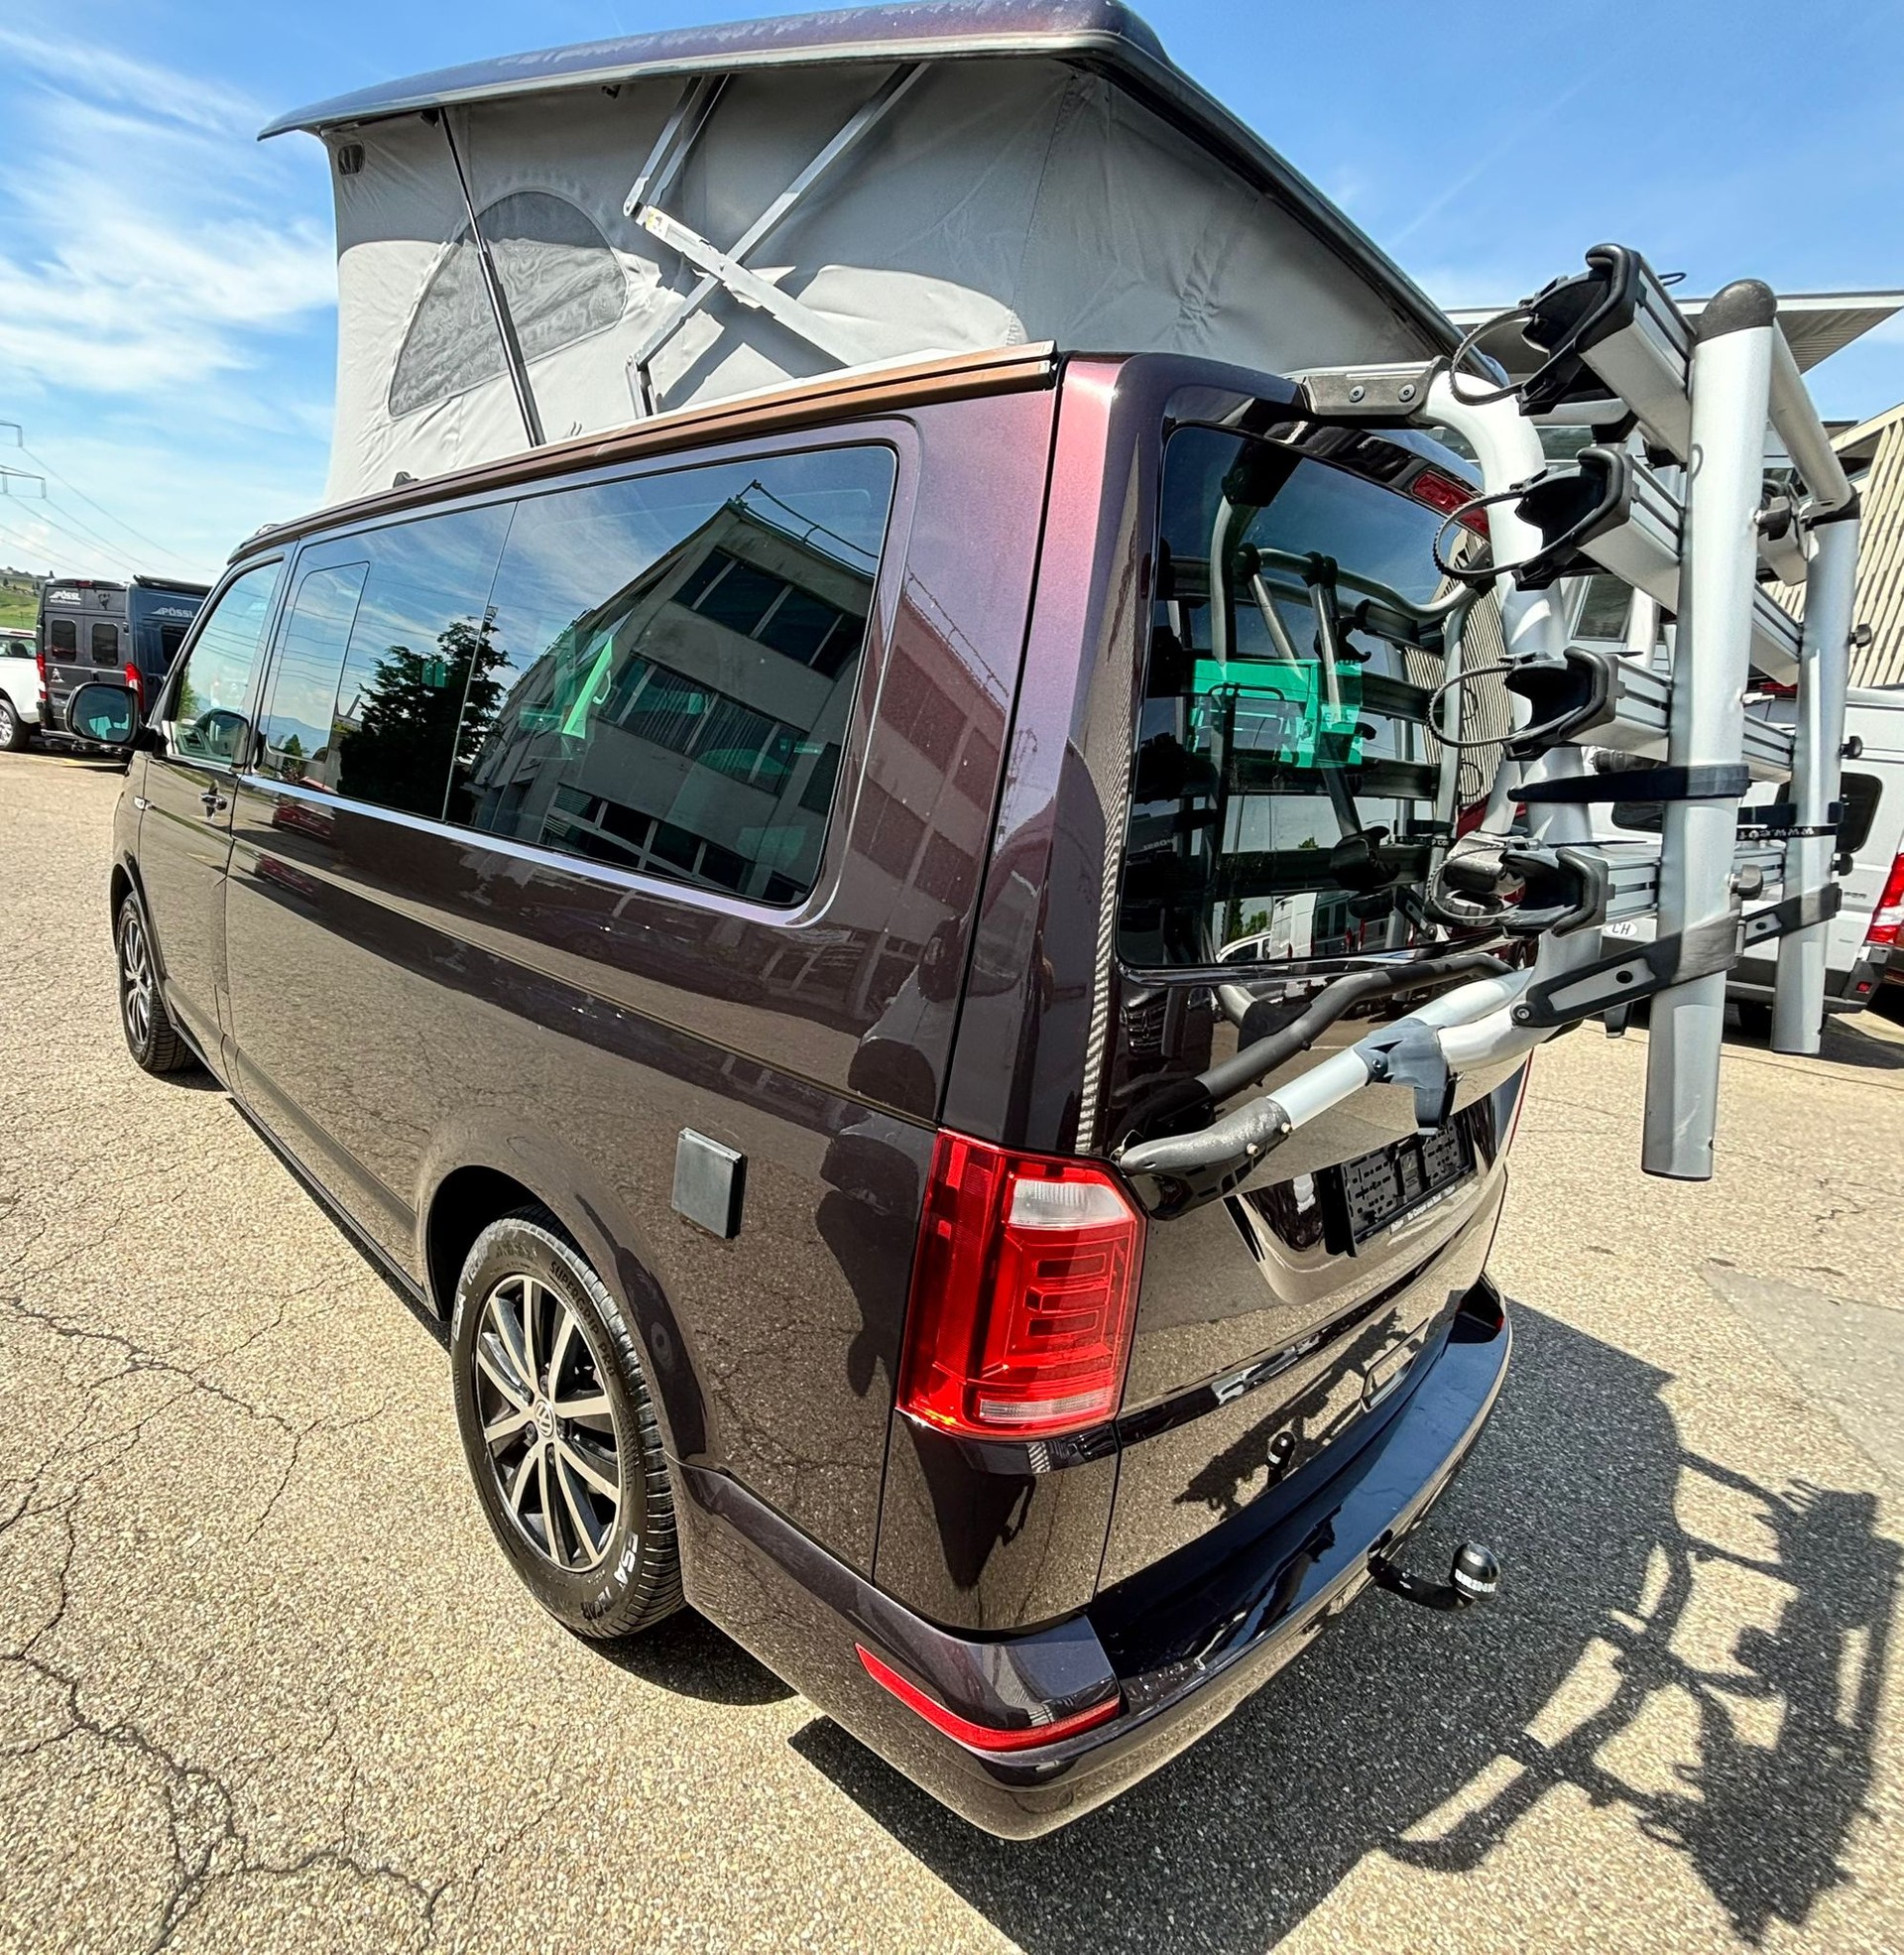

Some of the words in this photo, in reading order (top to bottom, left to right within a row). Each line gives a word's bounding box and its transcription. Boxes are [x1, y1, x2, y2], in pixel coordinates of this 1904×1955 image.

[161, 607, 195, 618] PÖSSL
[1612, 922, 1631, 935] CH
[549, 1261, 599, 1335] SUPERGRIP
[597, 1342, 615, 1377] PRO
[613, 1532, 639, 1586] ESA
